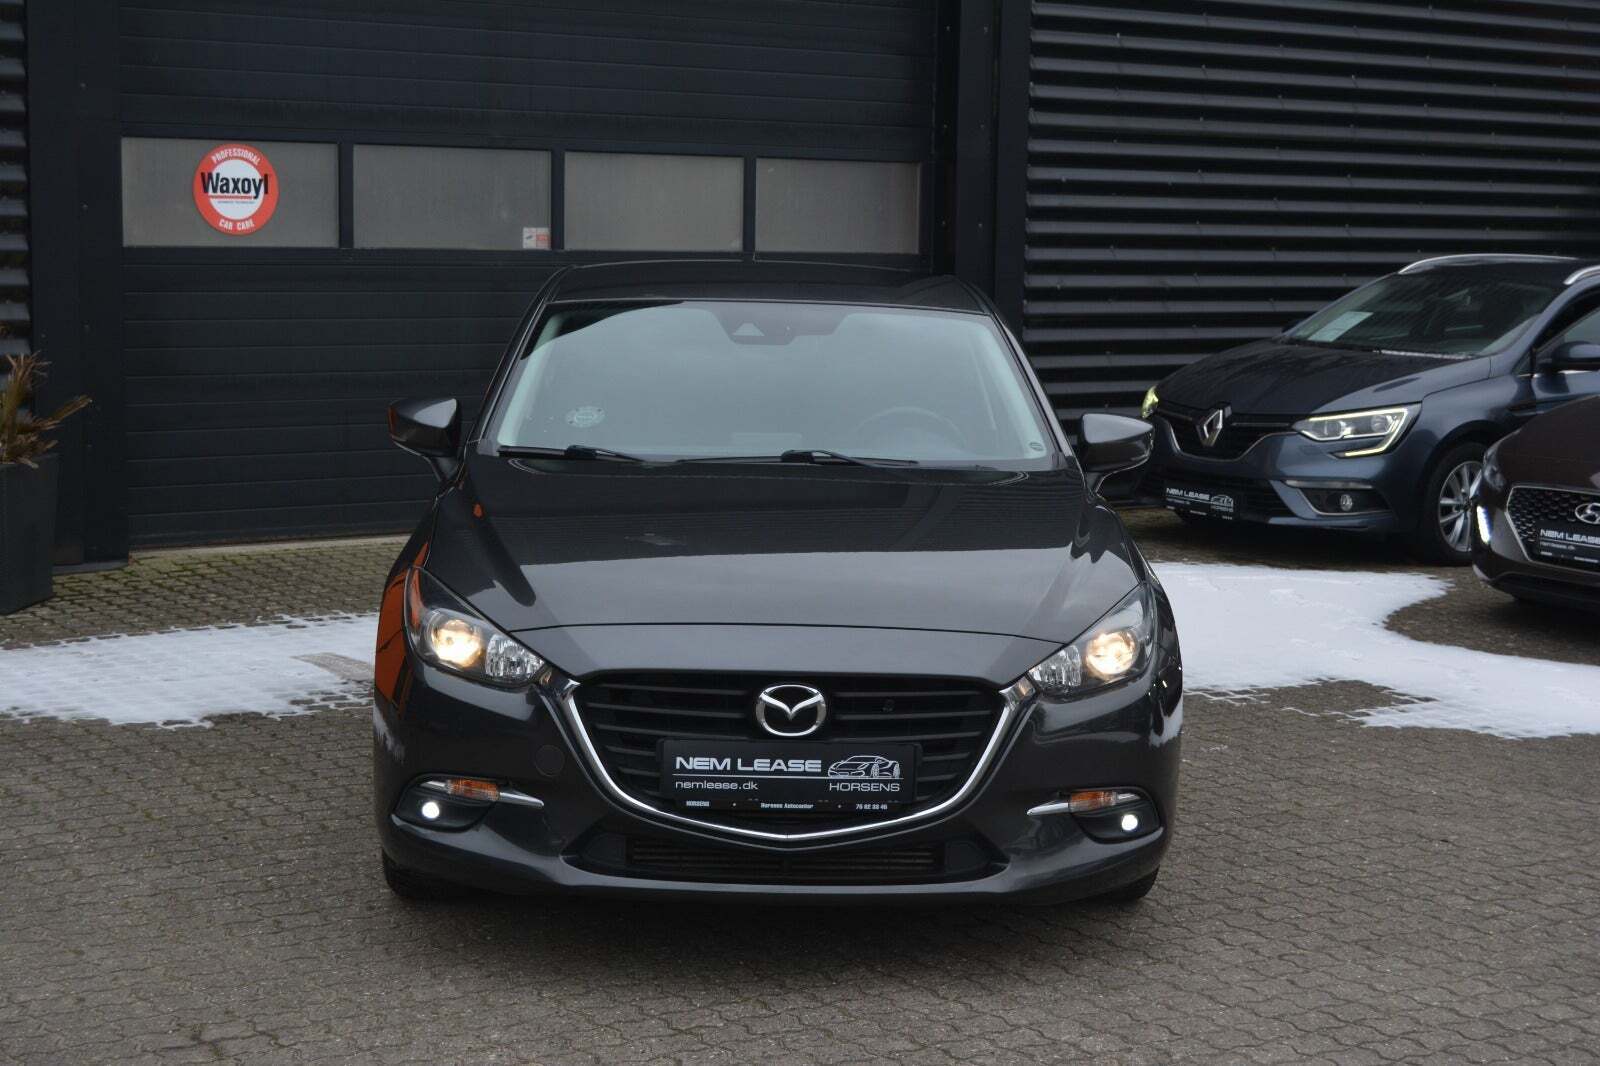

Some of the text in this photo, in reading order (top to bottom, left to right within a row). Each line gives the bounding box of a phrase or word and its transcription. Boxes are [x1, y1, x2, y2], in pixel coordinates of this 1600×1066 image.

[212, 148, 260, 165] PROFESSIONAL
[200, 171, 269, 200] Waxoyl
[219, 218, 255, 230] CAR CARE
[1540, 528, 1564, 539] NEM
[675, 756, 822, 773] NEM LEASE
[675, 780, 759, 791] nemlease.dk
[829, 782, 900, 792] HORSENS
